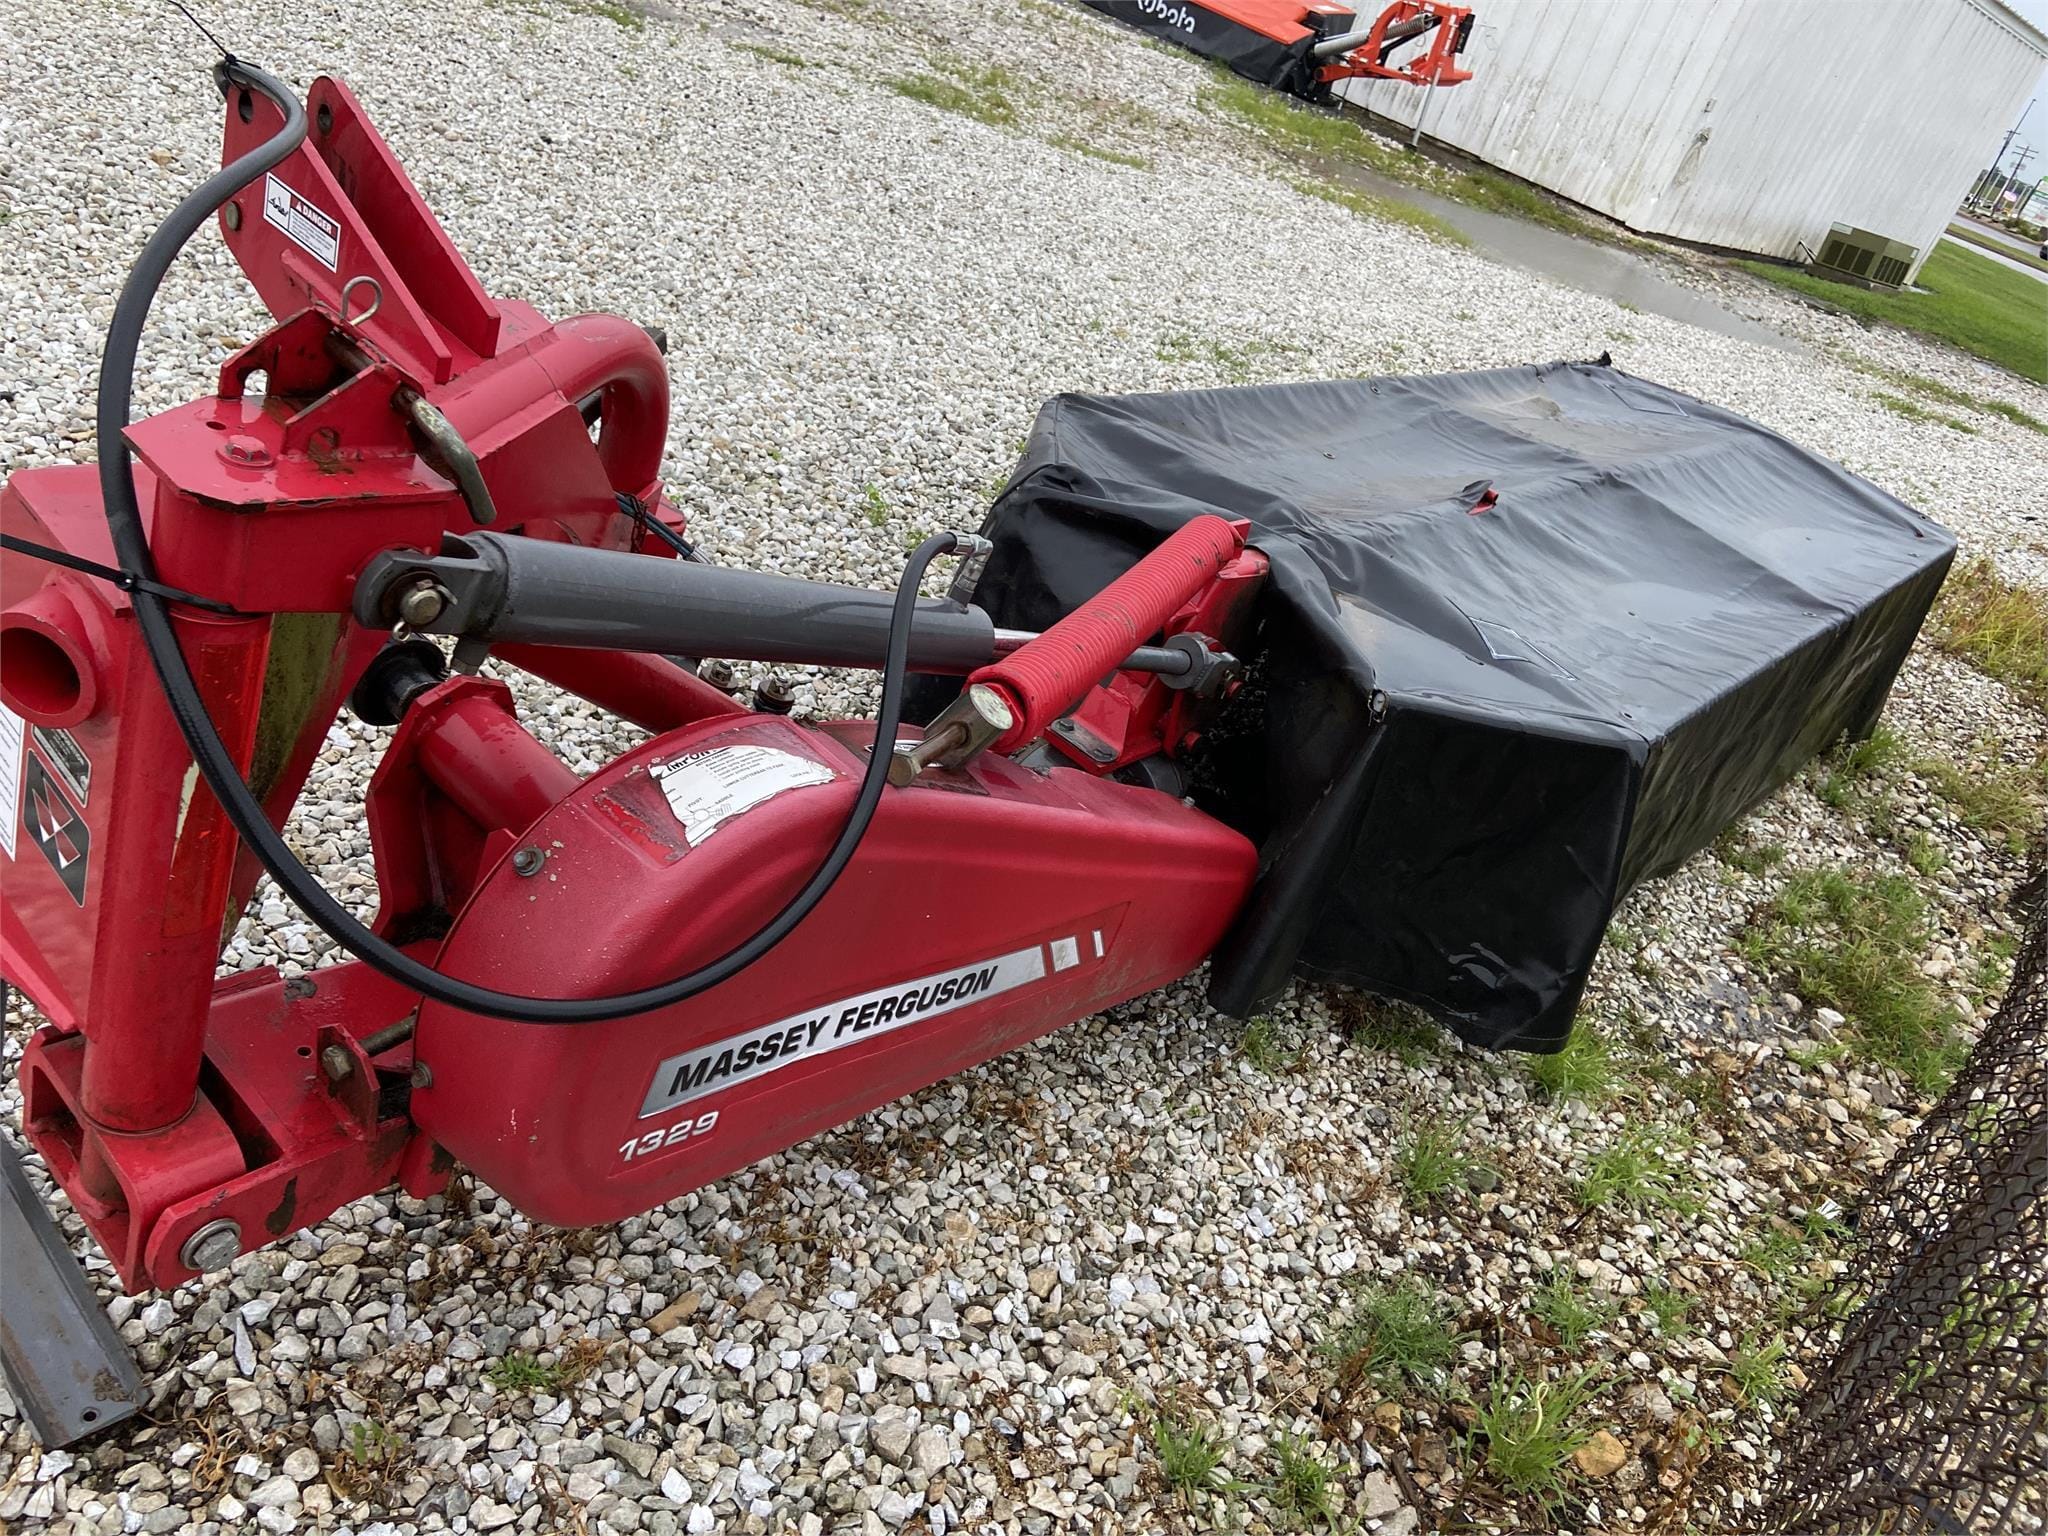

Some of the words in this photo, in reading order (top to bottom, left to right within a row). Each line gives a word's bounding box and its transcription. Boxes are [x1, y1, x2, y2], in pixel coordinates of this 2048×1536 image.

[302, 204, 333, 235] DANGER
[667, 1016, 832, 1097] MASSEY
[833, 965, 999, 1039] FERGUSON
[618, 1110, 720, 1162] 1329
